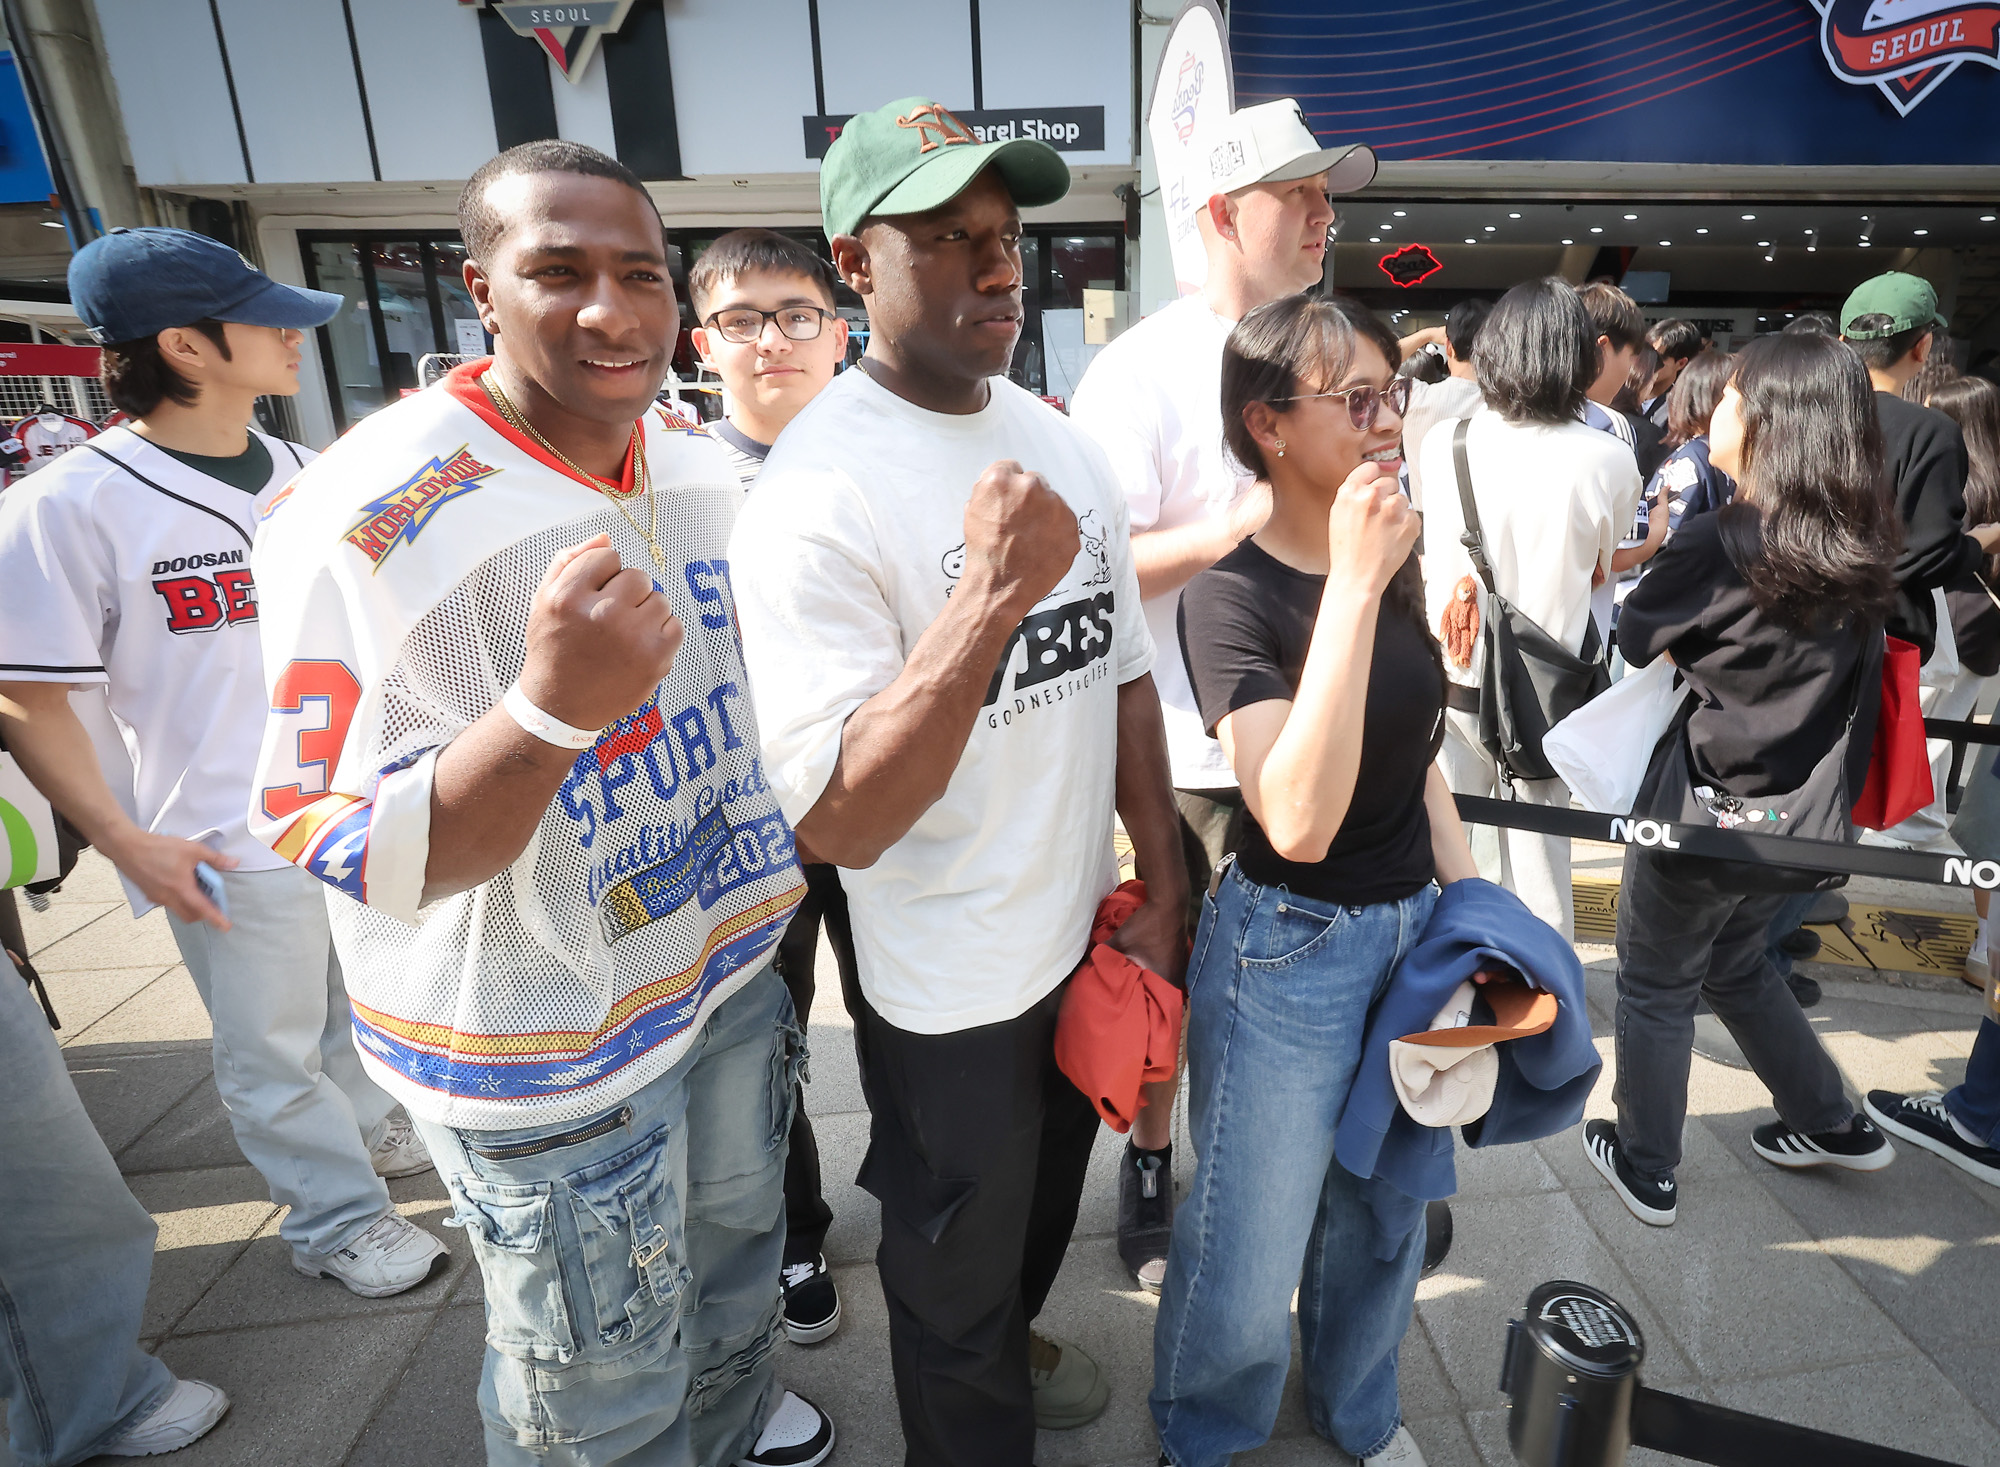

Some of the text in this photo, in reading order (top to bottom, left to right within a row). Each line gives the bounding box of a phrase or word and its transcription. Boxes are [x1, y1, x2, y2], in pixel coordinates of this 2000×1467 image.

[530, 7, 591, 23] SEOUL
[1869, 18, 1965, 64] SEOUL
[967, 120, 1016, 142] arel
[1022, 119, 1080, 144] Shop
[347, 451, 494, 562] WORLDWIDE
[151, 549, 243, 575] DOOSAN
[152, 568, 259, 635] BE
[262, 659, 363, 821] 3
[1609, 817, 1681, 849] NOL
[717, 821, 796, 889] 202
[1943, 857, 2000, 889] NO
